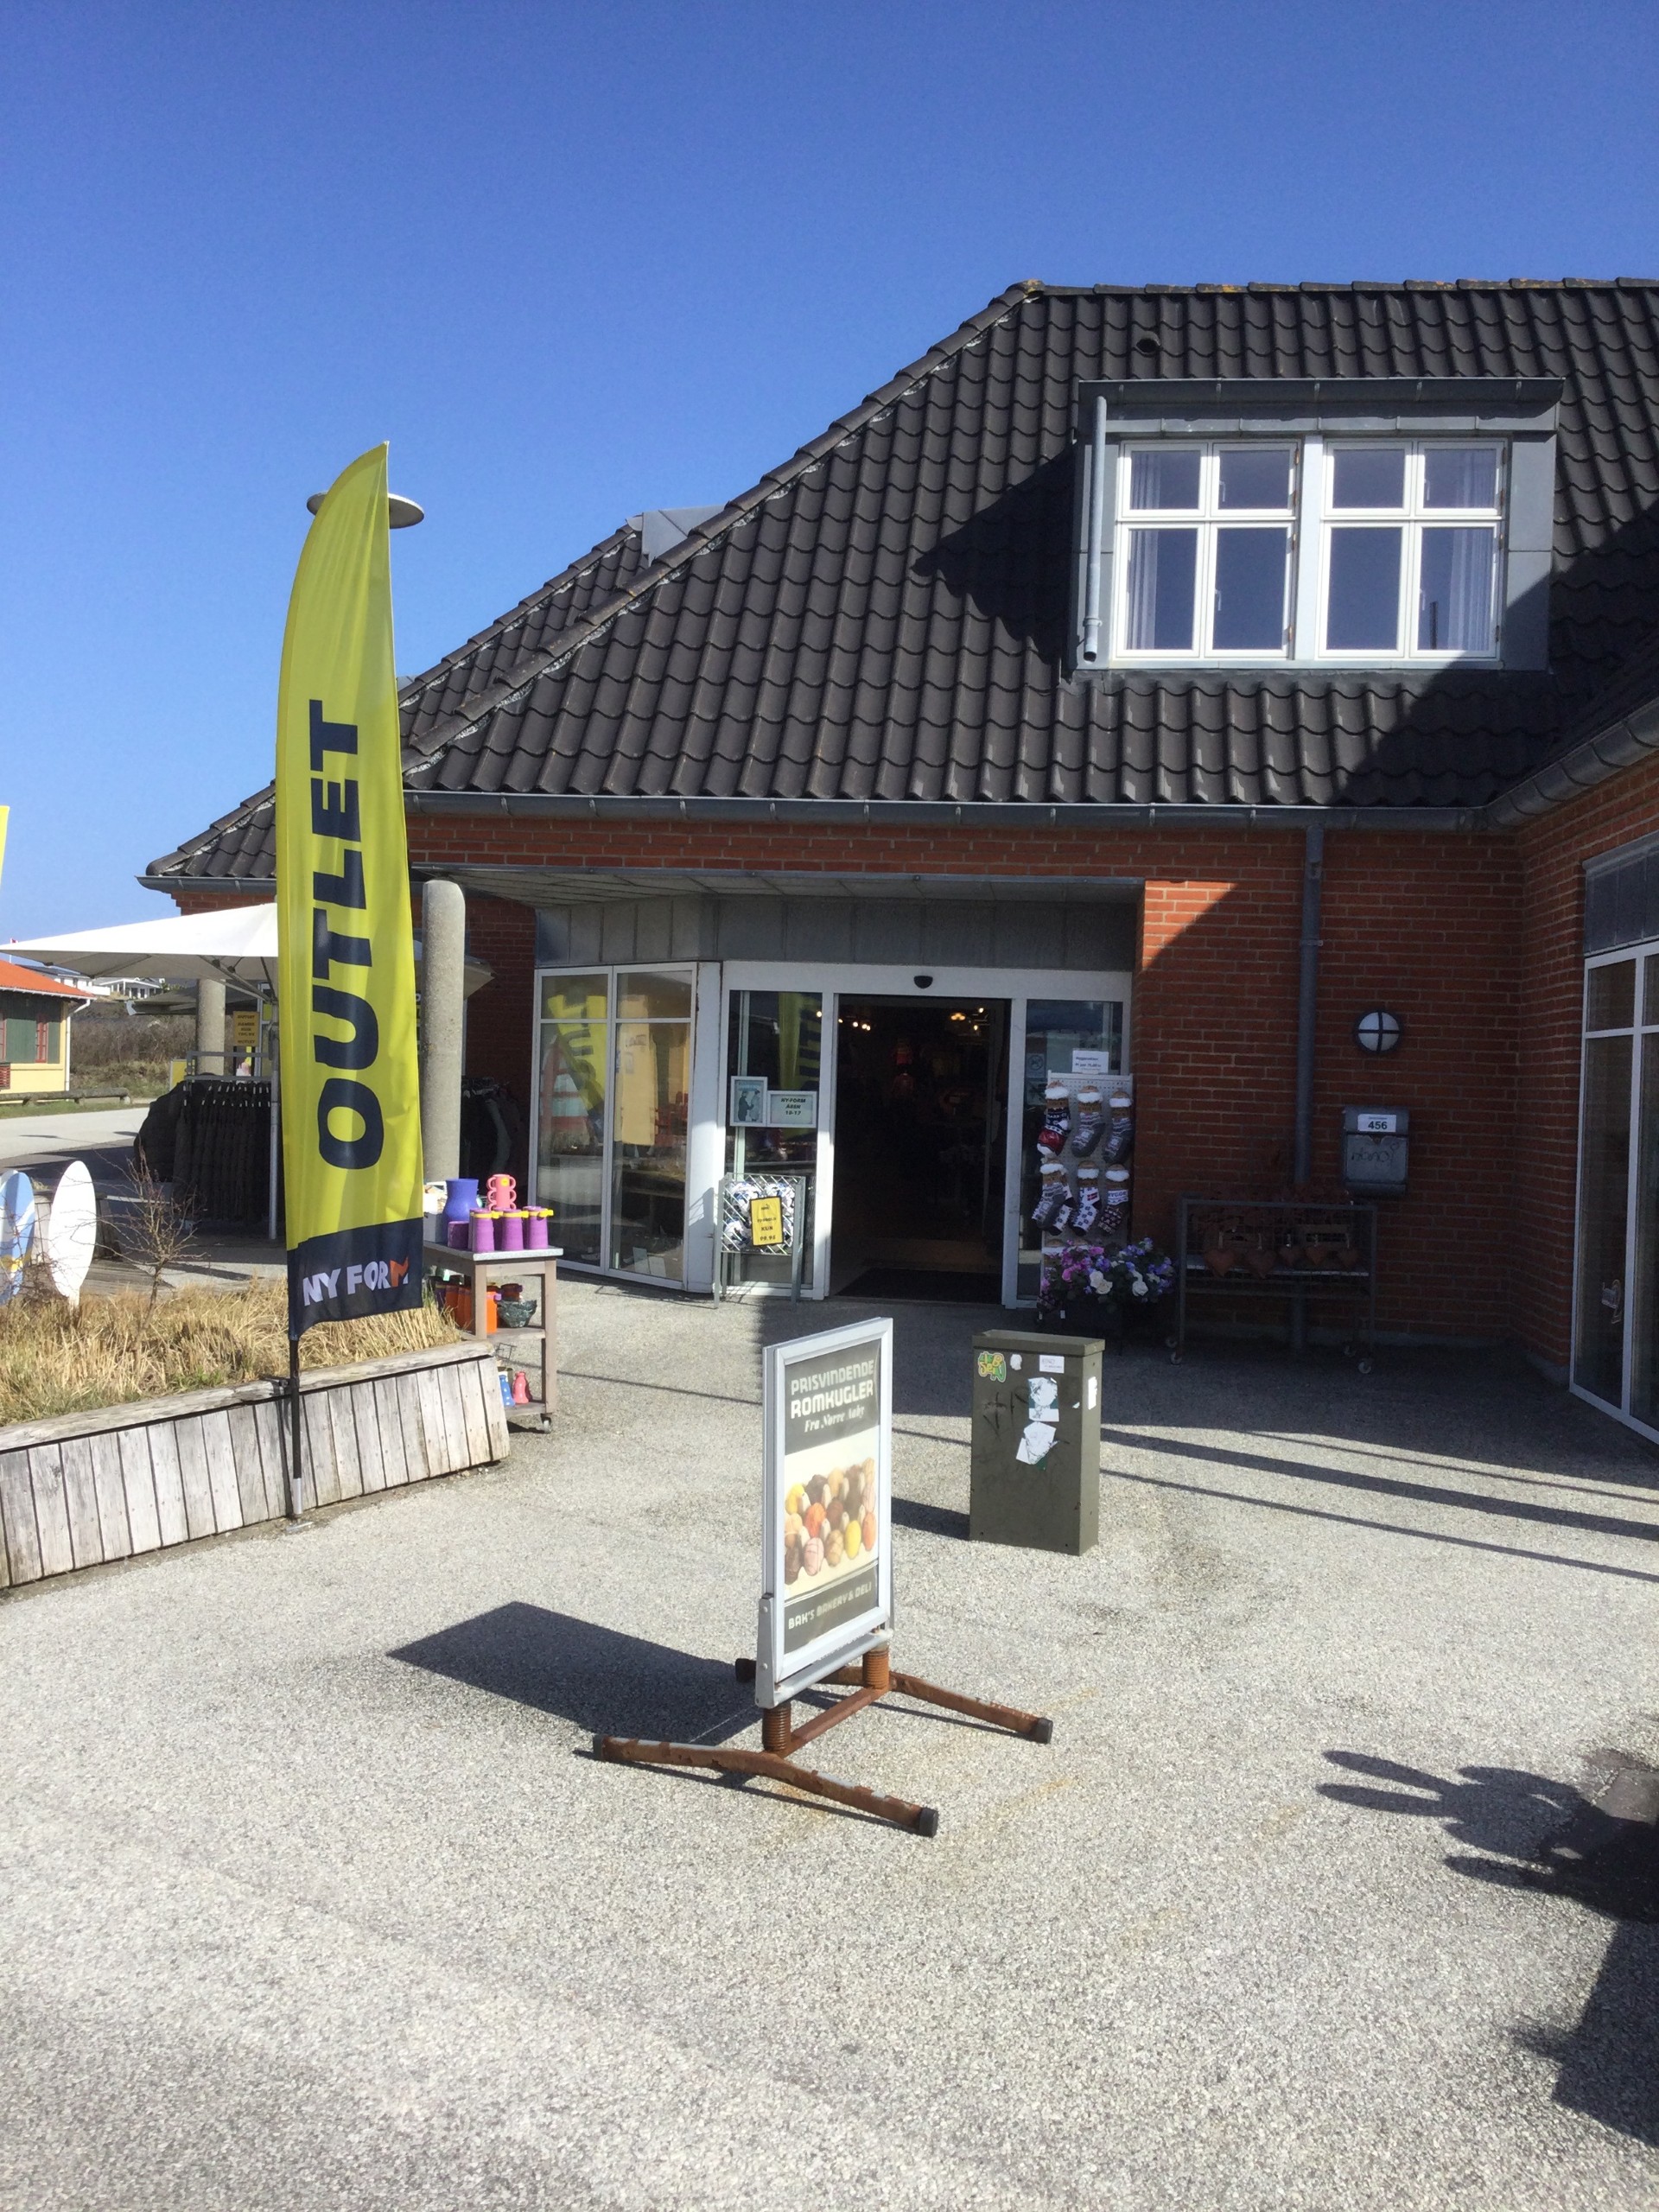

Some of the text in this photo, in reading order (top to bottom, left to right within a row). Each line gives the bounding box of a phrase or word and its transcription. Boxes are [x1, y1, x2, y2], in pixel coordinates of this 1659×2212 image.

[308, 699, 385, 1170] OUTLET
[1367, 1121, 1388, 1130] 456
[302, 1256, 409, 1306] NY FORM
[791, 1360, 874, 1395] PRISVINDENDE
[791, 1380, 873, 1419] ROMKUGLER
[804, 1420, 820, 1433] Fra
[855, 1582, 871, 1598] DELI
